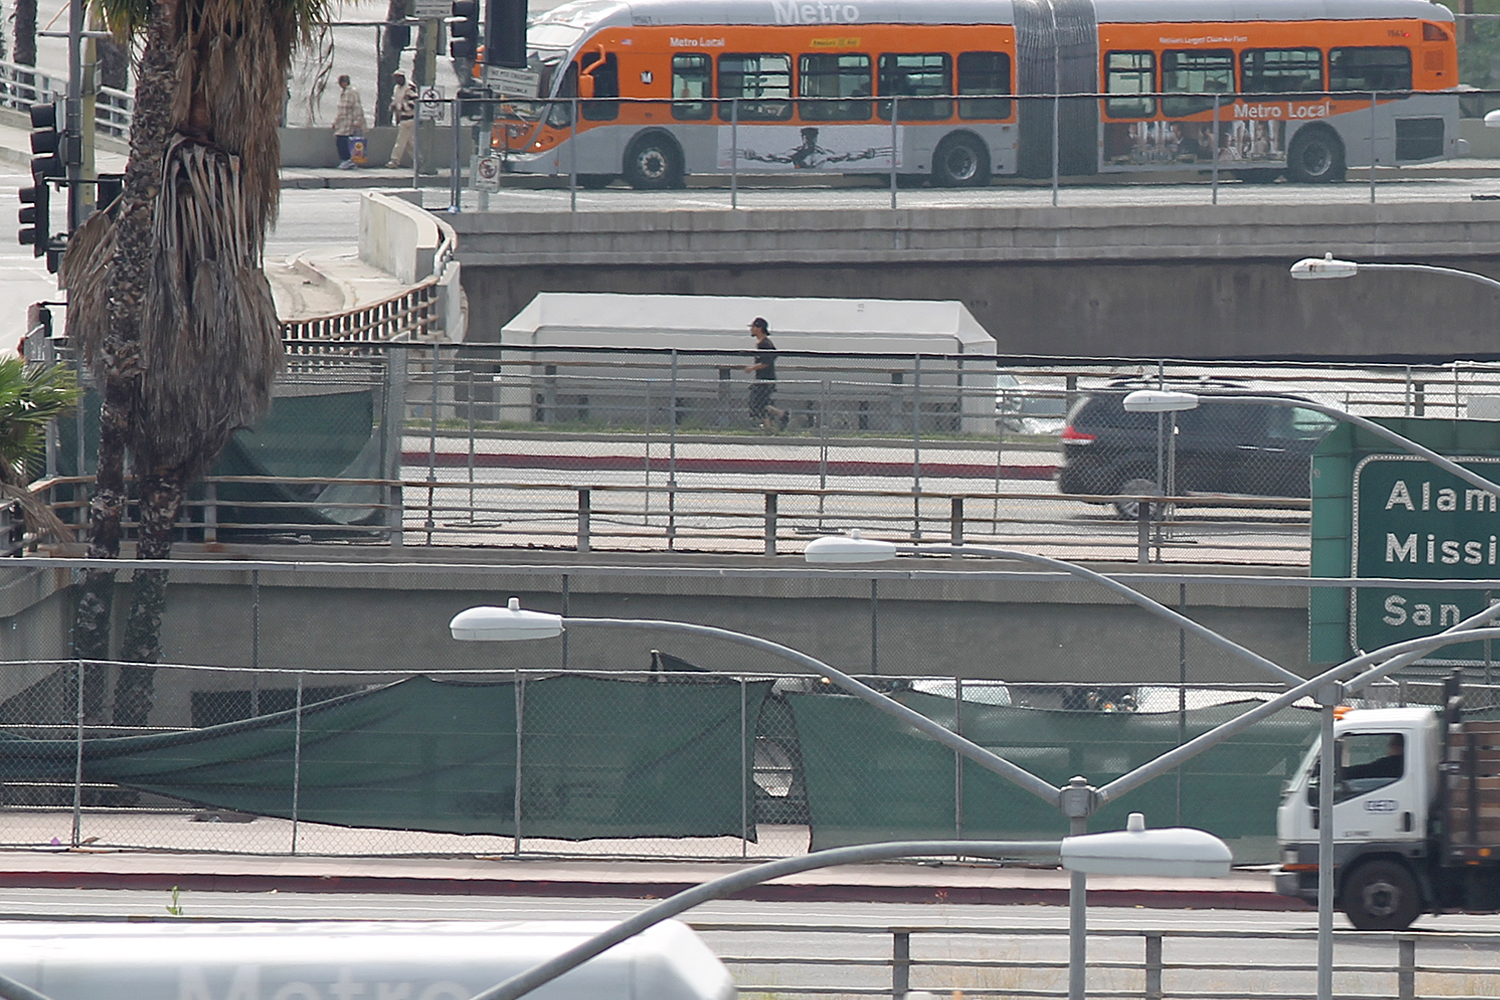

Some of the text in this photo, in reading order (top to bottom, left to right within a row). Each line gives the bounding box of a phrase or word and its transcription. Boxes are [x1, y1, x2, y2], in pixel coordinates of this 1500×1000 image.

[773, 1, 859, 24] Metro
[670, 37, 725, 47] Metro Local
[1234, 101, 1330, 118] Metro Local
[1382, 594, 1461, 626] San
